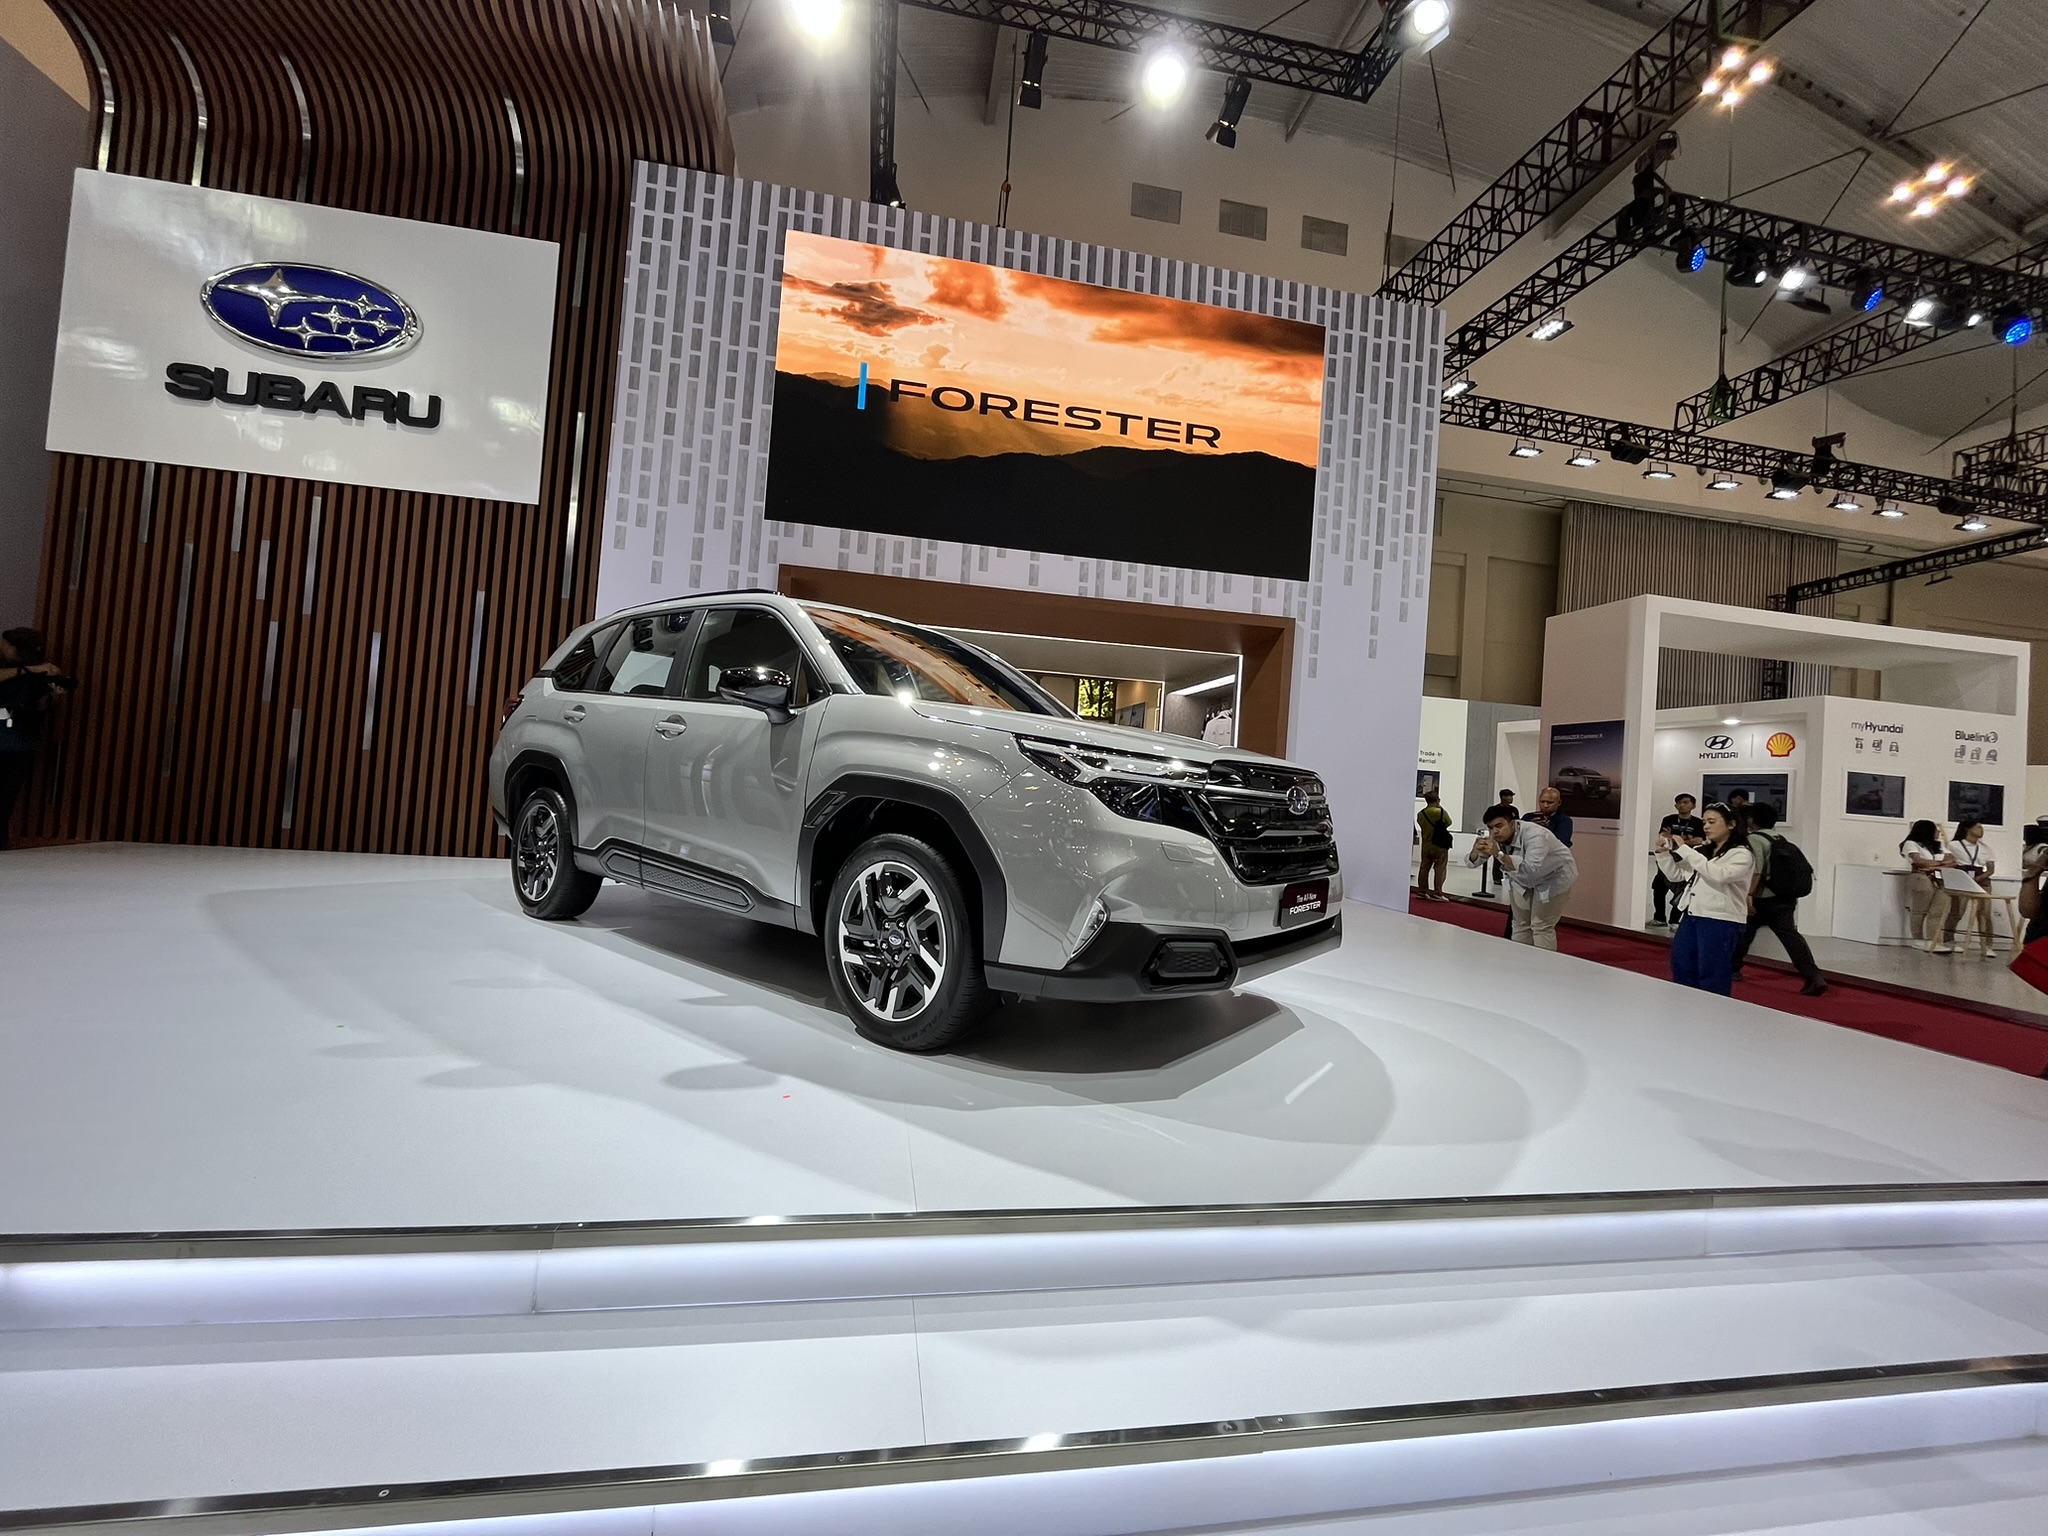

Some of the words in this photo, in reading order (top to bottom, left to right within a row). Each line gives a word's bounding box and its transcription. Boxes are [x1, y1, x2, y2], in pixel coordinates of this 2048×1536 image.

[165, 362, 442, 429] SUBARU
[890, 379, 1221, 448] FORESTER
[1851, 721, 1904, 734] myHyundai
[1955, 730, 1990, 743] Bluelink
[1290, 900, 1321, 915] FORESTER
